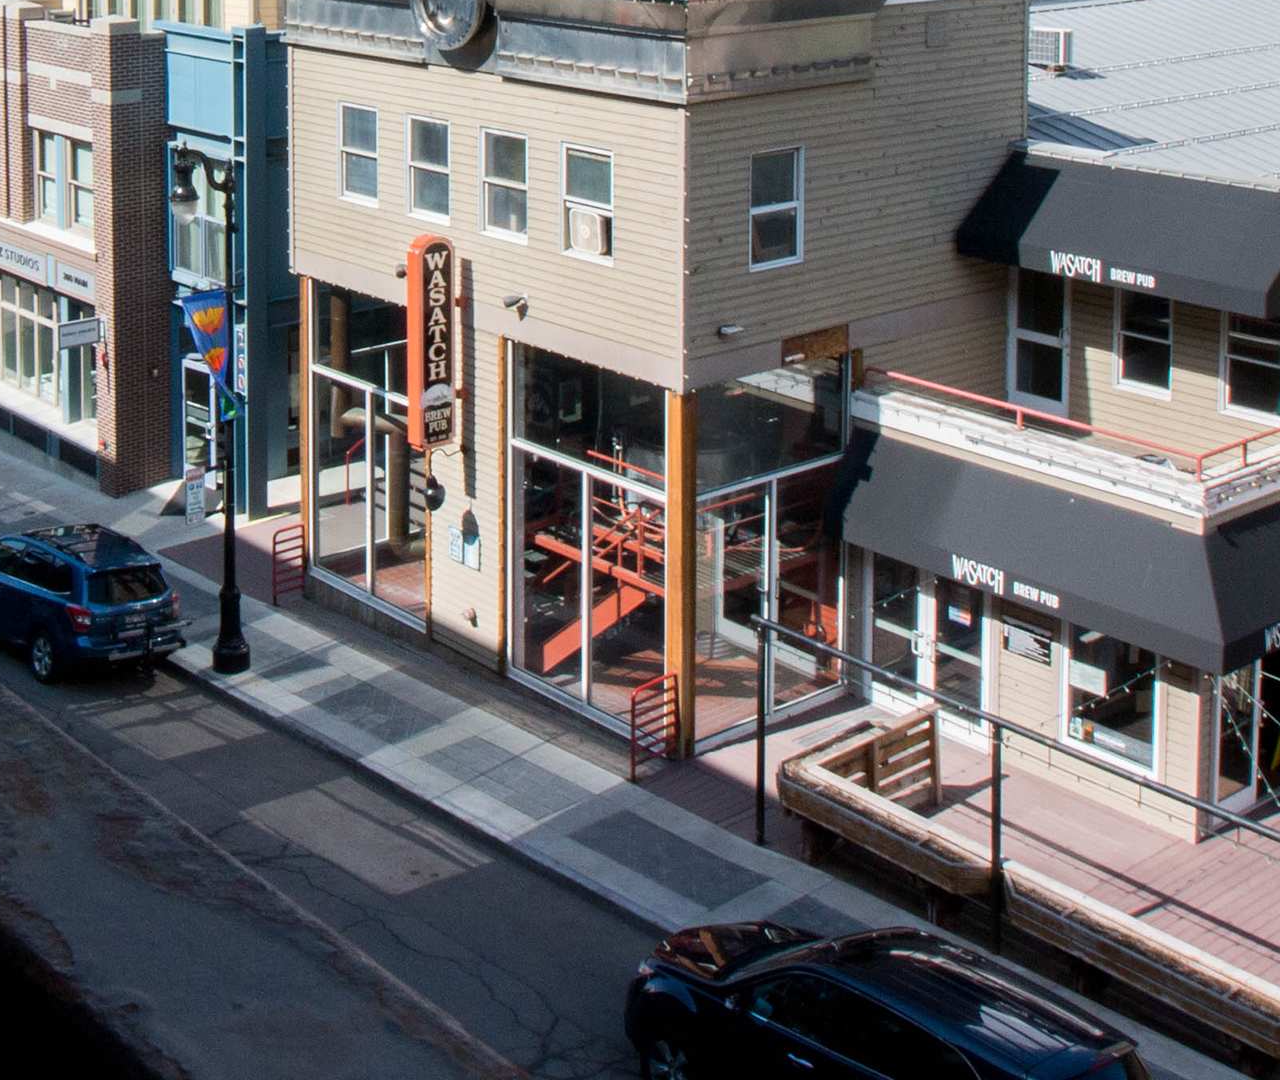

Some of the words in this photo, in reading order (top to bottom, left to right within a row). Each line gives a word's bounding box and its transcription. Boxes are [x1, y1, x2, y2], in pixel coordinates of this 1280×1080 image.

[4, 248, 40, 271] STUDIOS
[1050, 249, 1102, 283] WASATCH
[1109, 267, 1136, 285] BREW
[1136, 273, 1155, 289] PUB
[424, 250, 449, 381] WASATCH
[425, 406, 451, 423] BREW
[429, 419, 448, 433] PUB
[952, 553, 1004, 595] WASATCH
[1013, 581, 1040, 602] BREW
[1040, 590, 1060, 609] PUB
